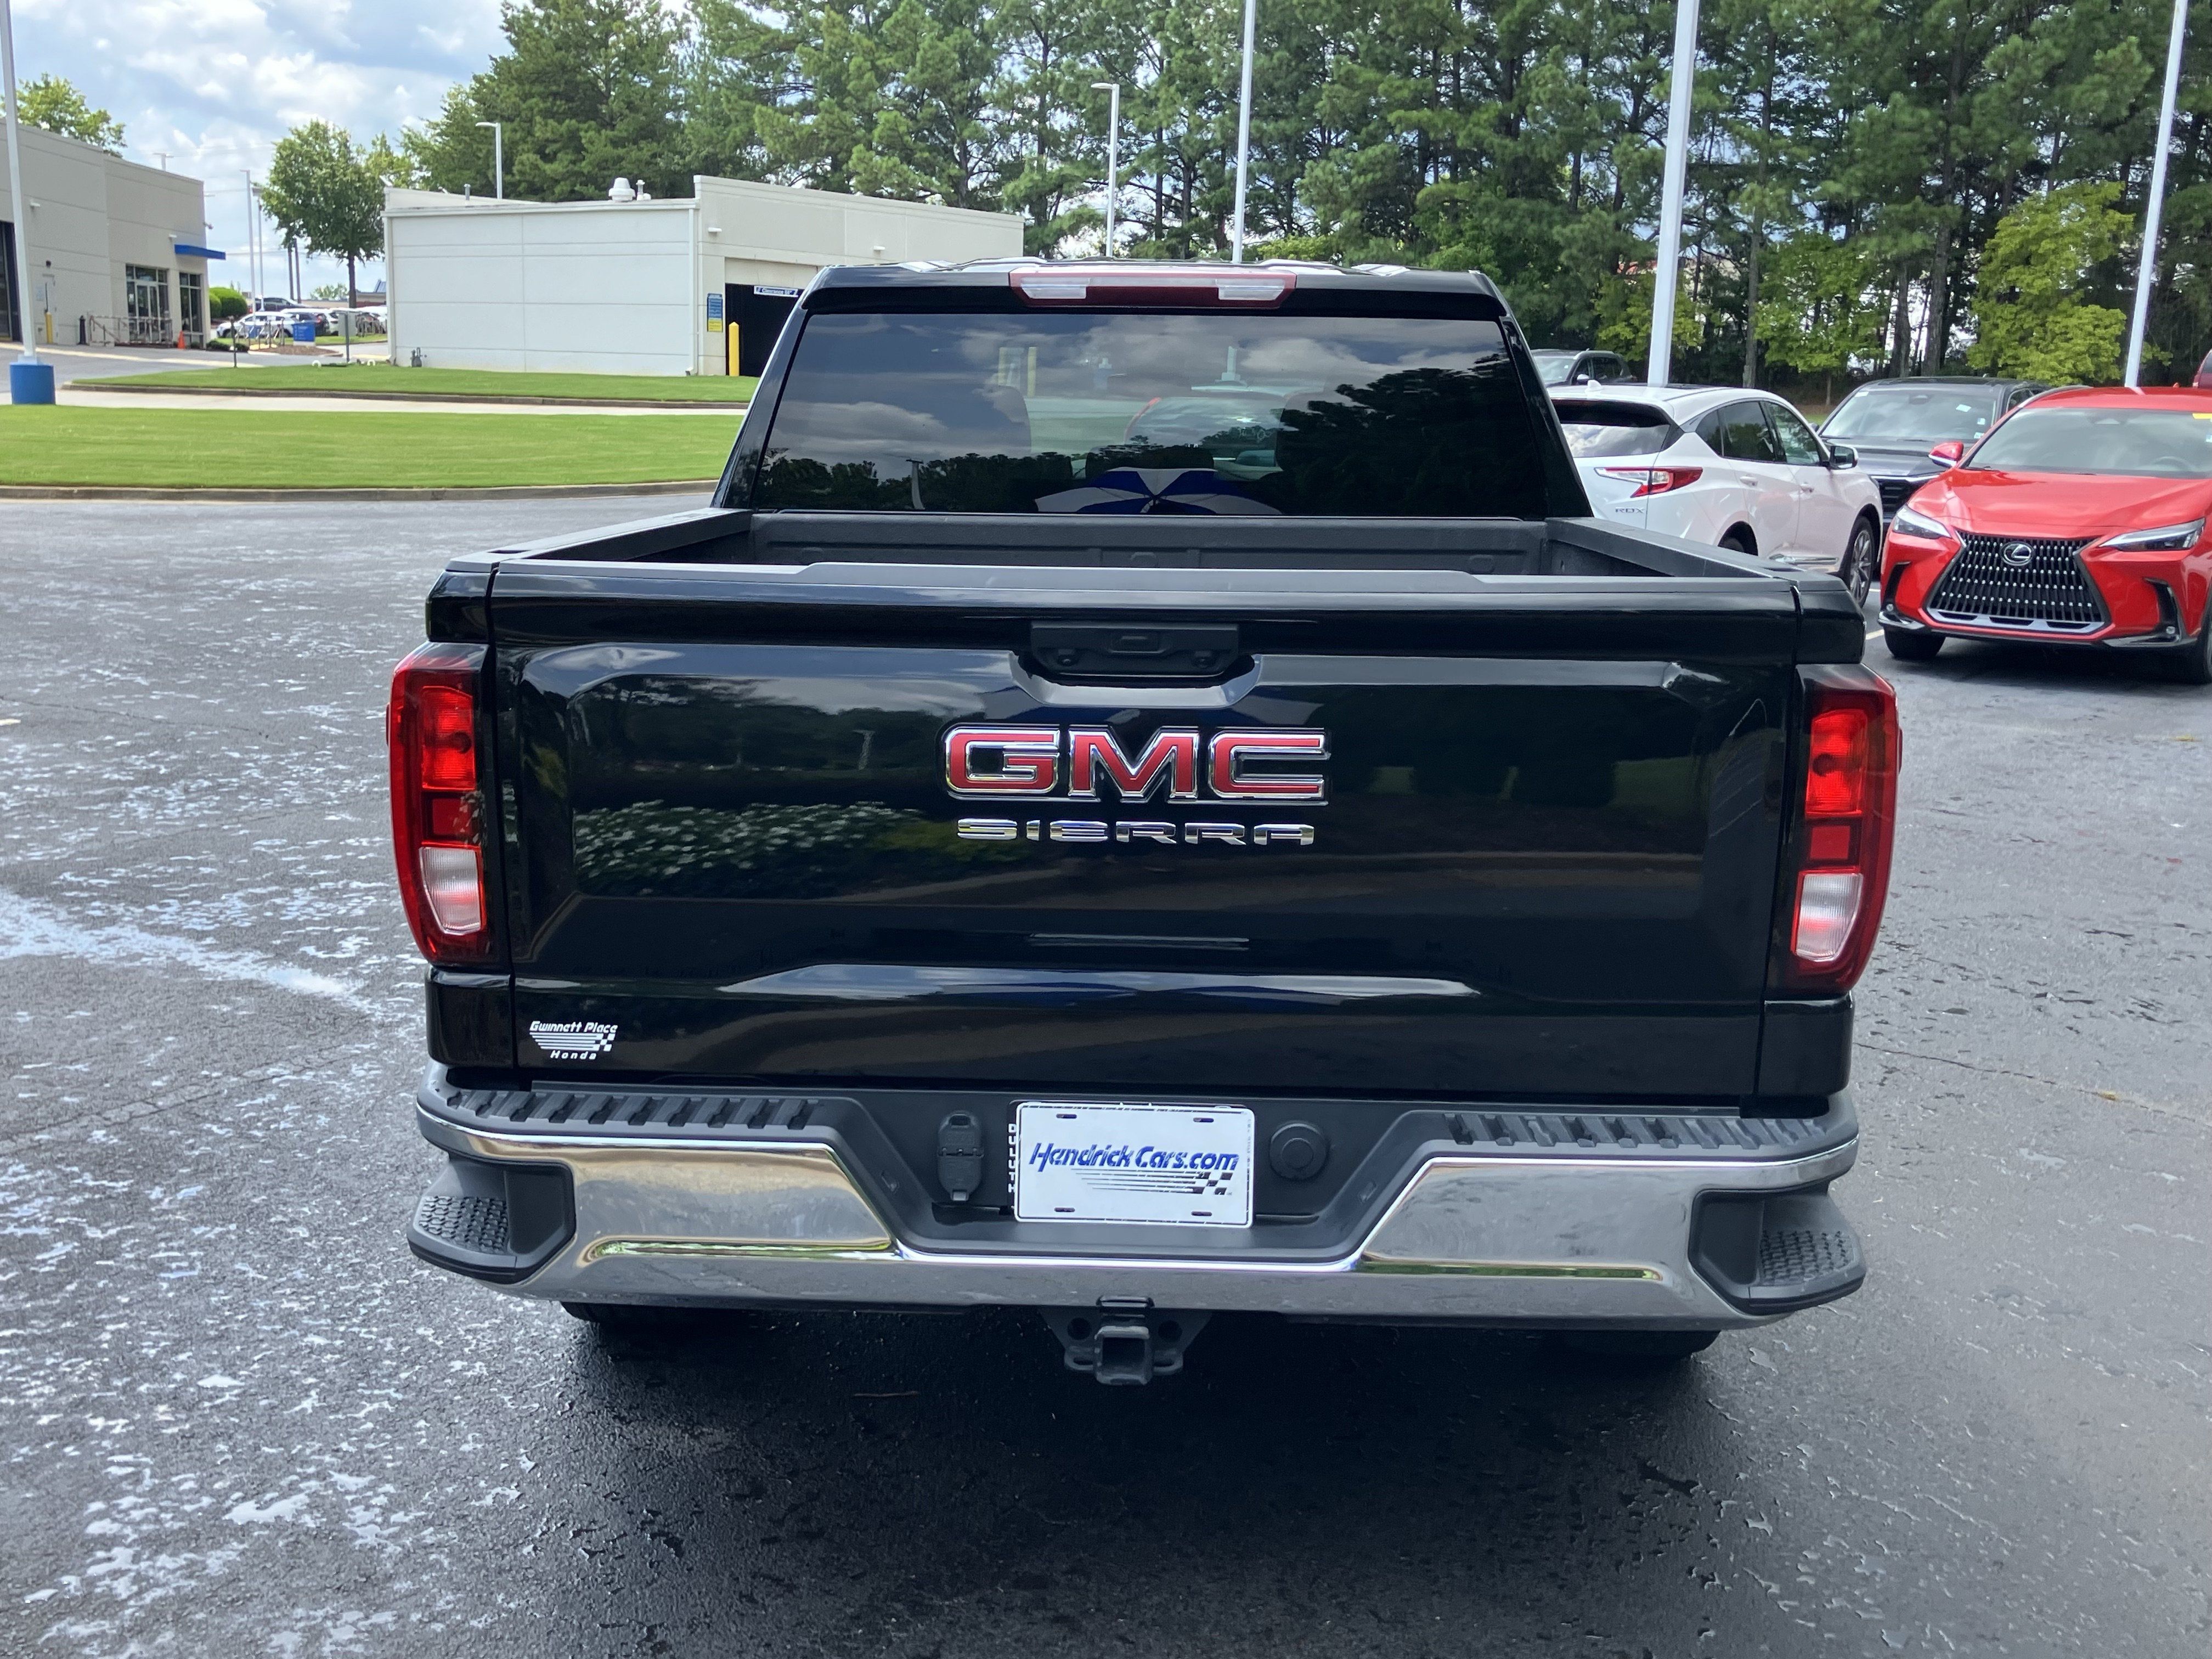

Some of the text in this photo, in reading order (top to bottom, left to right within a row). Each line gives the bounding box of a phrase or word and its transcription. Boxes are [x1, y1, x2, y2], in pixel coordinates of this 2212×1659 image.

[945, 725, 1325, 800] GMC
[957, 818, 1314, 845] SIERRA
[529, 1020, 618, 1033] Gwinnett Place
[550, 1050, 597, 1060] Honda
[1029, 1142, 1239, 1172] Hendrick Cars.com
